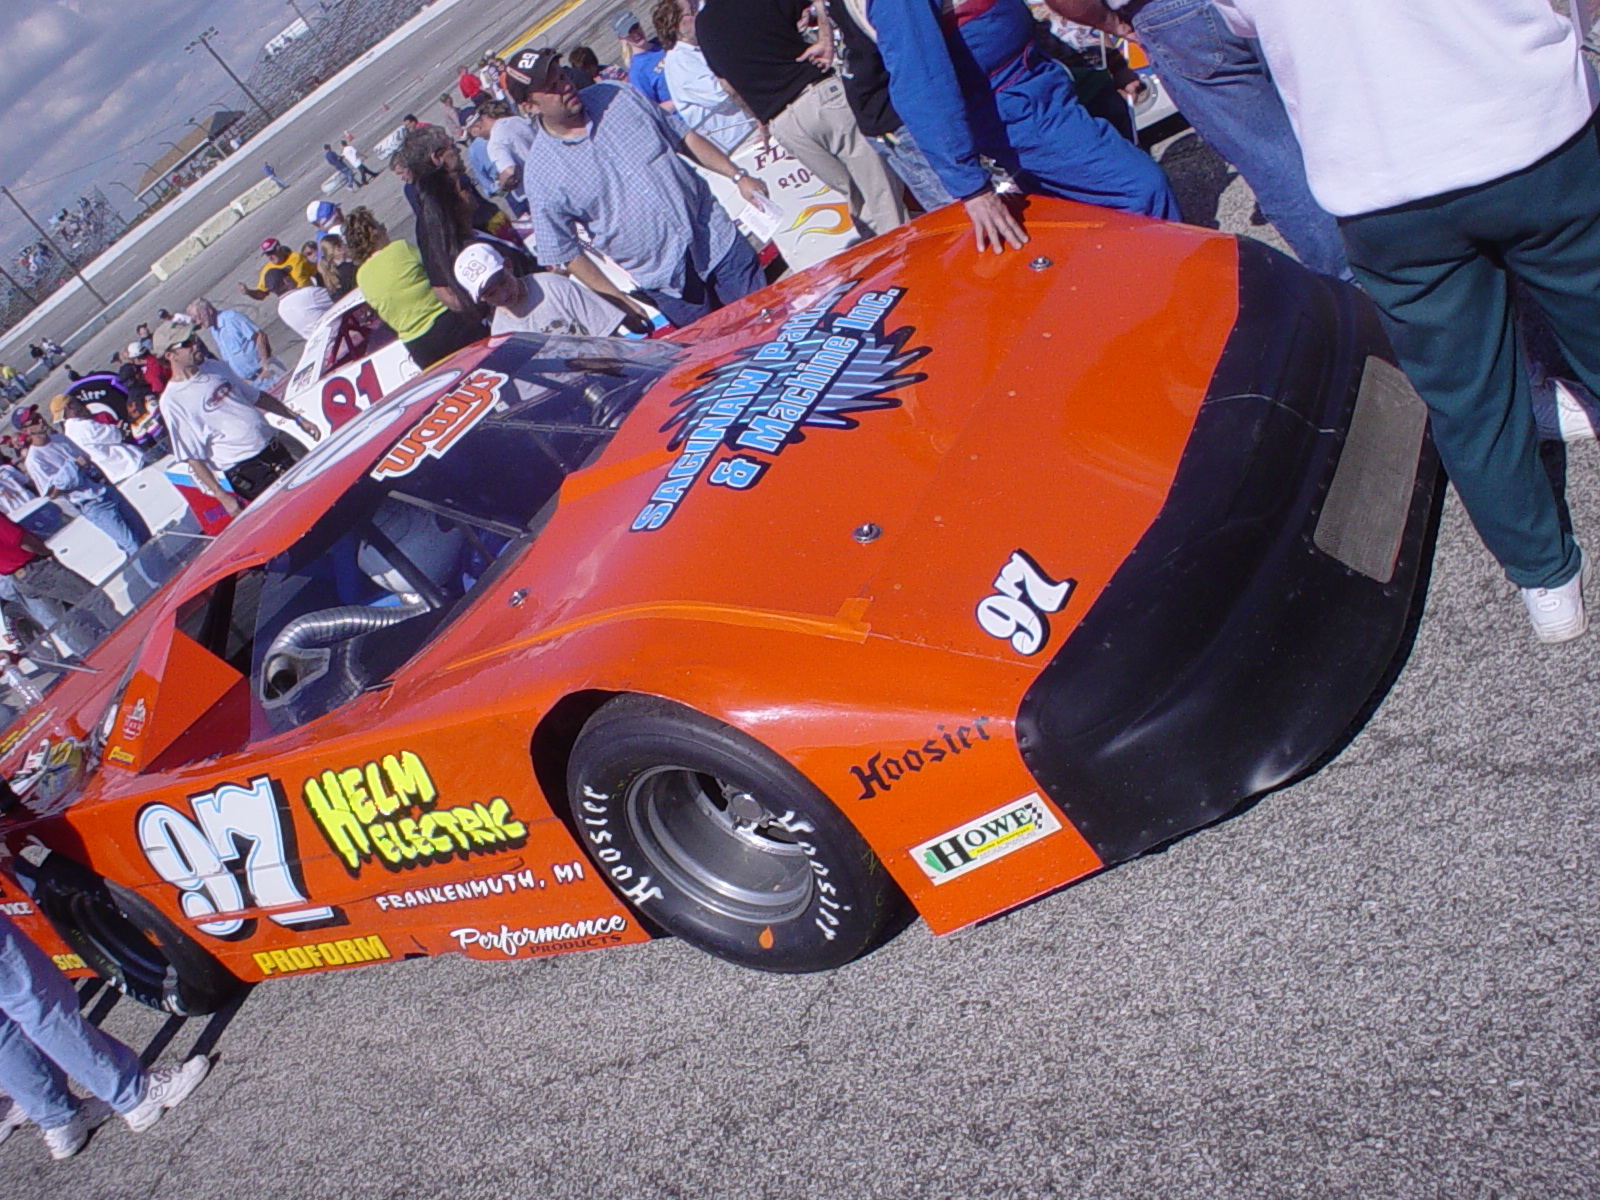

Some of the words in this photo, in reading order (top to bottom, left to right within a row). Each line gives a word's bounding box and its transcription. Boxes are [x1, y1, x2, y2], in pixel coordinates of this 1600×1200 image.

[709, 457, 763, 490] &
[736, 335, 860, 453] Machine
[832, 287, 901, 331] Inc.
[631, 368, 773, 531] SAGINAW
[976, 550, 1074, 656] 97
[304, 750, 437, 869] HELM
[850, 715, 990, 800] Hoosier
[136, 775, 340, 937] 97
[368, 797, 528, 864] ELECTRIC
[576, 785, 664, 906] Hoosier
[768, 810, 852, 940] Hoosier
[375, 869, 545, 911] FRANKENMUTH,
[553, 861, 584, 884] MI
[450, 914, 628, 957] Performance
[252, 935, 391, 975] PROFORM
[529, 934, 623, 955] PRODUCTS
